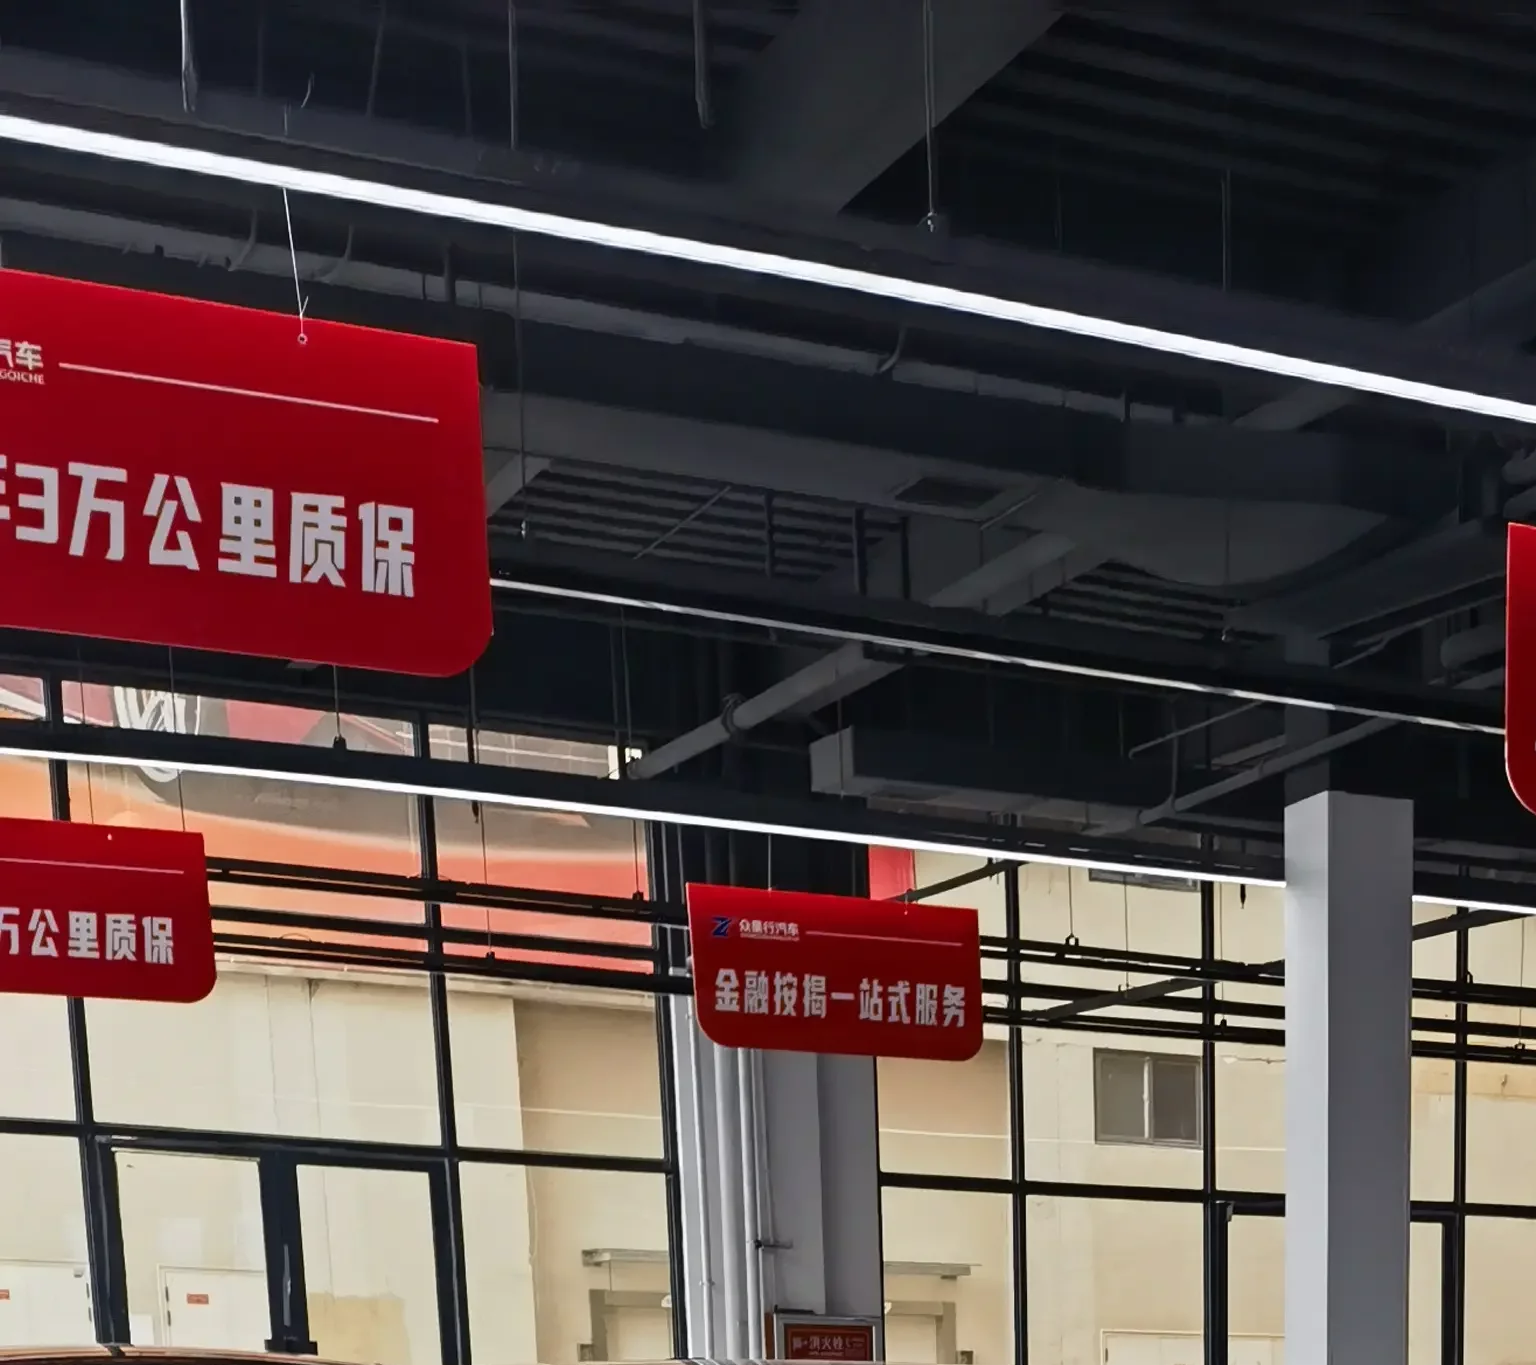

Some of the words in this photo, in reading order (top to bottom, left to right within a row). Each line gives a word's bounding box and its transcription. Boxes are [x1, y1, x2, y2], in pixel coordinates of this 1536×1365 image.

[0, 454, 415, 598] 3万公里质保
[714, 968, 966, 1028] 金融按揭一站式服务
